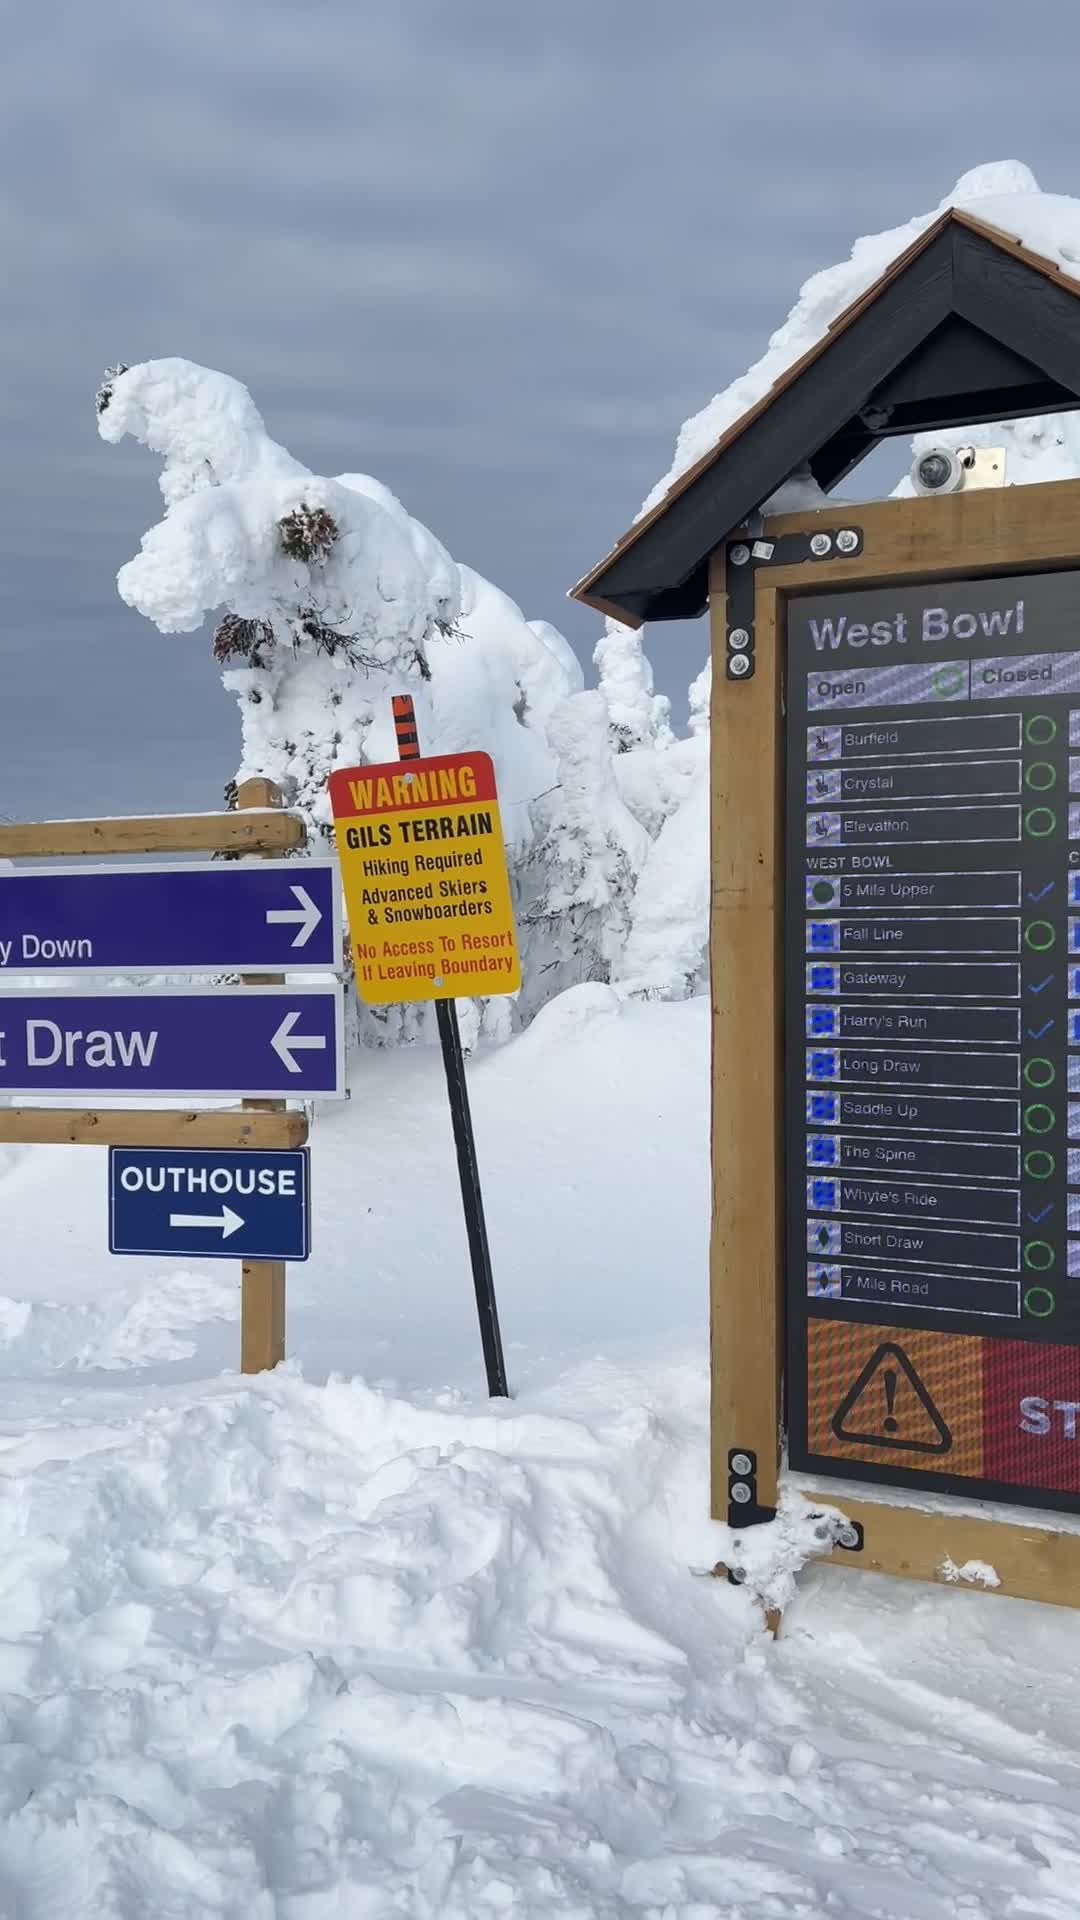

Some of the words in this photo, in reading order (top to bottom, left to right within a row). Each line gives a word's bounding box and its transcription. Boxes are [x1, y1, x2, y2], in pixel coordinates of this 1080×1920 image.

[808, 612, 908, 651] West
[922, 600, 1024, 641] Bowl
[816, 679, 866, 699] Open
[981, 663, 1053, 686] Closed
[844, 731, 899, 747] Burfield
[348, 765, 477, 810] WARNING
[844, 776, 894, 792] Crystal
[345, 823, 392, 850] GILS
[398, 811, 493, 844] TERRAIN
[844, 818, 909, 833] Elevation
[362, 857, 409, 877] Hiking
[415, 848, 483, 875] Required
[806, 856, 846, 869] WEST
[851, 855, 894, 869] BOWL
[362, 882, 433, 905] Advanced
[439, 879, 487, 899] Skiers
[843, 884, 853, 897] 5
[856, 882, 886, 897] Mile
[889, 882, 935, 900] Upper
[367, 909, 379, 925] &
[384, 899, 493, 925] Snowboarders
[843, 927, 869, 941] Fall
[872, 927, 904, 941] Line
[22, 934, 93, 959] Down
[357, 943, 377, 961] No
[382, 939, 435, 959] Access
[439, 935, 456, 953] To
[462, 930, 514, 951] Resort
[362, 966, 373, 982] If
[378, 960, 436, 981] Leaving
[442, 956, 514, 976] Boundary
[843, 971, 906, 988] Gateway
[843, 1014, 893, 1031] Harry's
[898, 1014, 927, 1029] Run
[26, 1019, 159, 1068] Draw
[843, 1058, 879, 1075] Long
[883, 1059, 921, 1074] Draw
[843, 1101, 893, 1116] Saddle
[897, 1104, 918, 1120] Up
[843, 1145, 870, 1159] The
[875, 1147, 916, 1164] Spine
[120, 1165, 297, 1197] OUTHOUSE
[843, 1187, 900, 1207] Whyte's
[904, 1191, 937, 1207] Ride
[844, 1231, 882, 1247] Short
[886, 1233, 924, 1250] Draw
[844, 1275, 853, 1288] 7
[857, 1275, 887, 1291] Mile
[891, 1279, 929, 1295] Road
